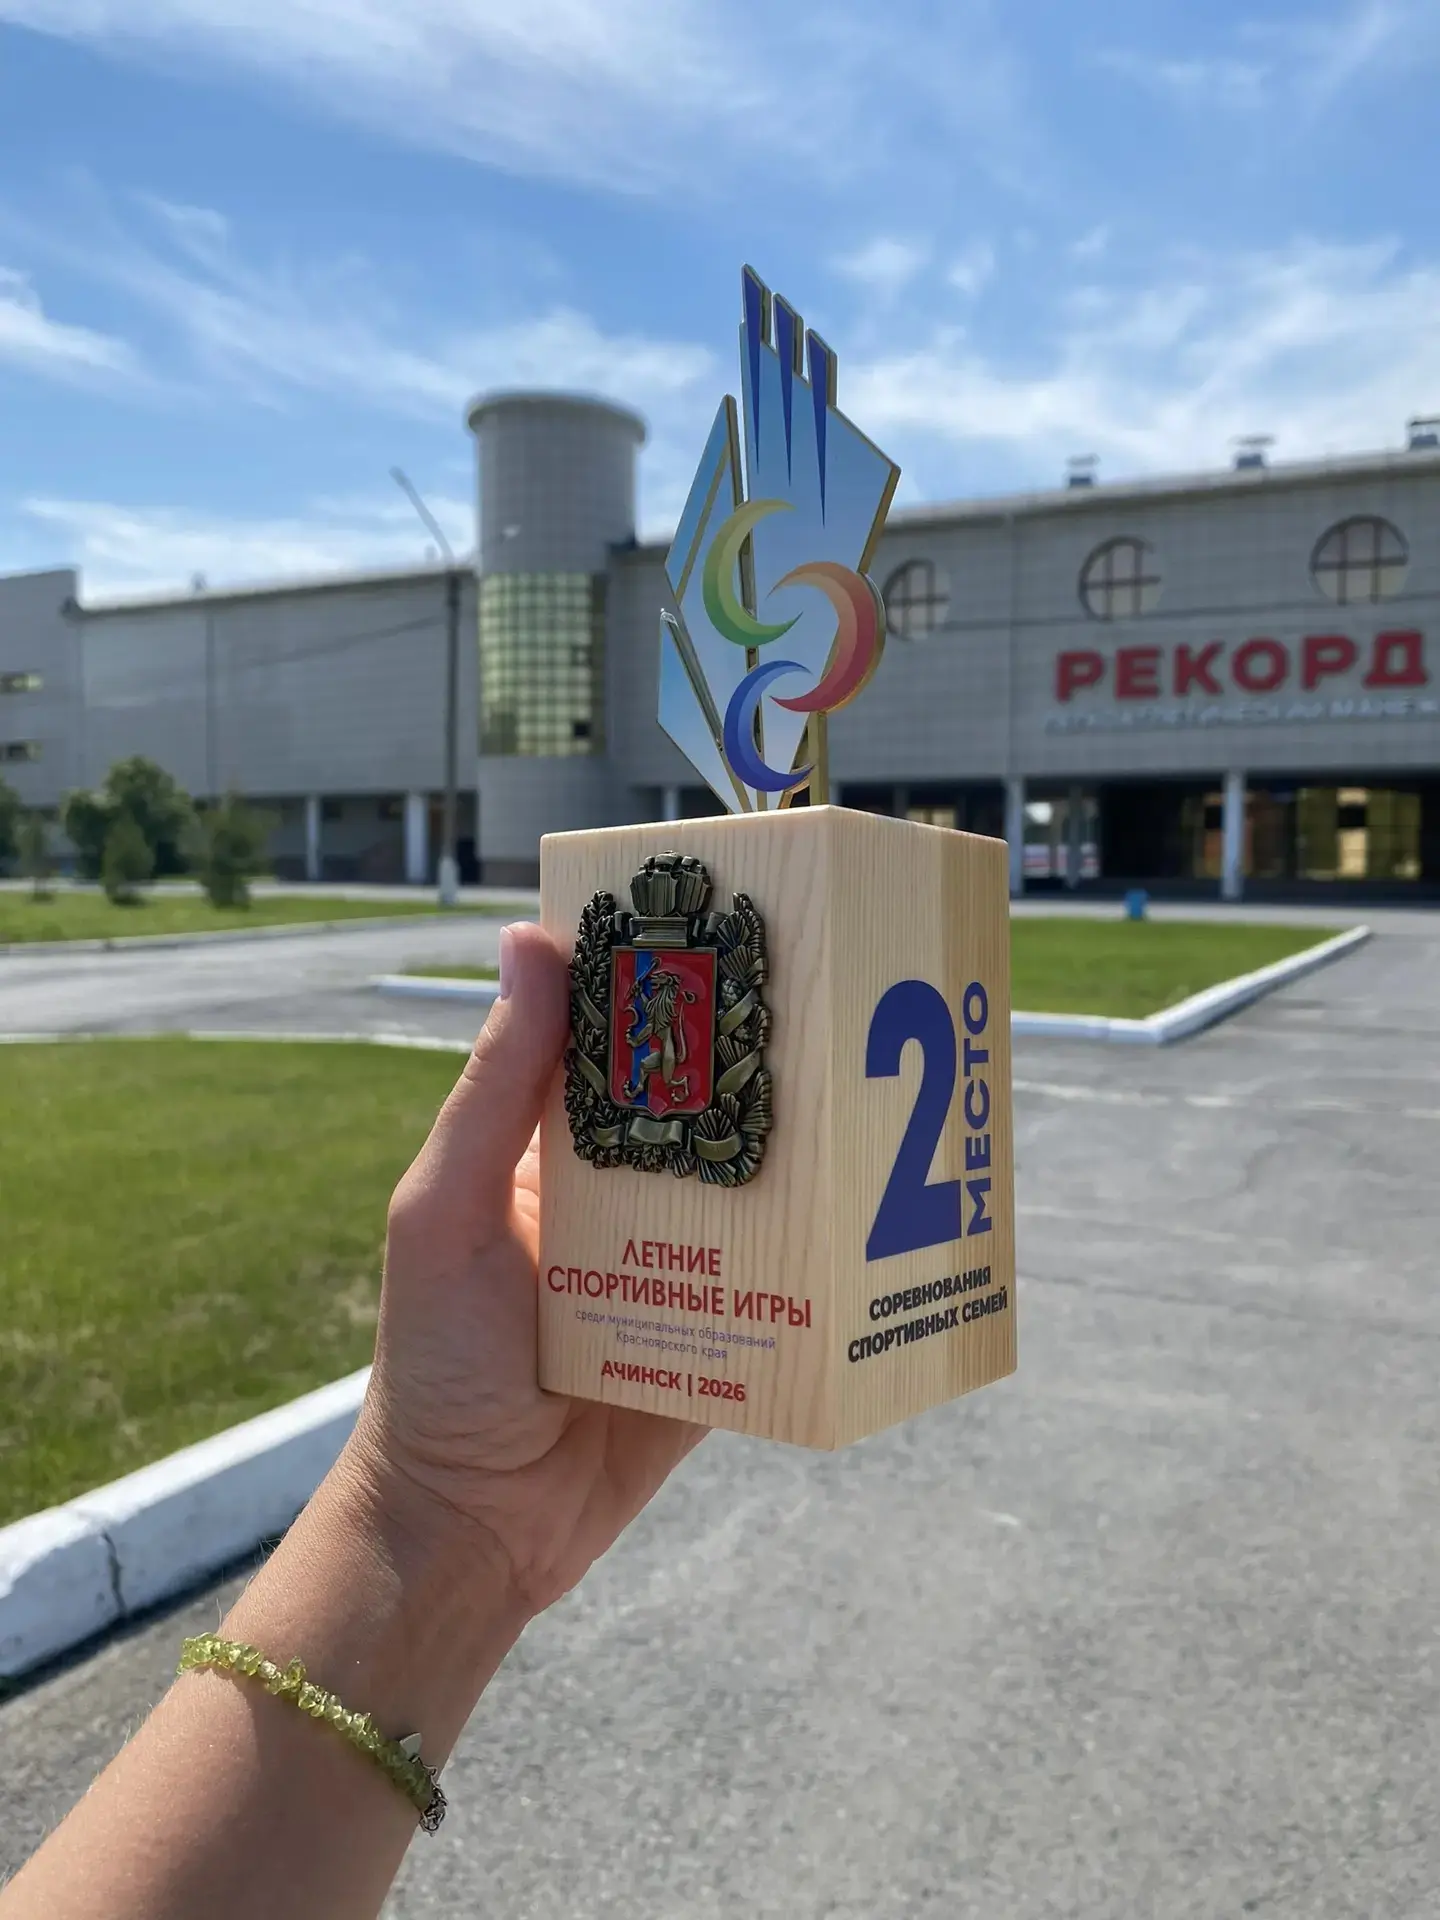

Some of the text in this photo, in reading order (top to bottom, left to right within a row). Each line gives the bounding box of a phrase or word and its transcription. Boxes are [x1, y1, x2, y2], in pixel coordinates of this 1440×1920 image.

[1055, 629, 1429, 702] РЕКОРД
[865, 980, 962, 1261] 2
[963, 981, 992, 1236] МЕСТО
[622, 1239, 721, 1276] ЛЕТНИЕ
[547, 1265, 811, 1328] СПОРТИВНЫЕ ИГРЫ
[869, 1266, 991, 1321] СОРЕВНОВАНИЯ
[575, 1309, 776, 1350] среди муниципальных образований
[616, 1331, 728, 1360] Красноярского края
[848, 1285, 1008, 1362] СПОРТИВНЫХ СЕМЕЙ
[601, 1359, 681, 1390] АЧИНСК
[698, 1376, 746, 1402] 2026
